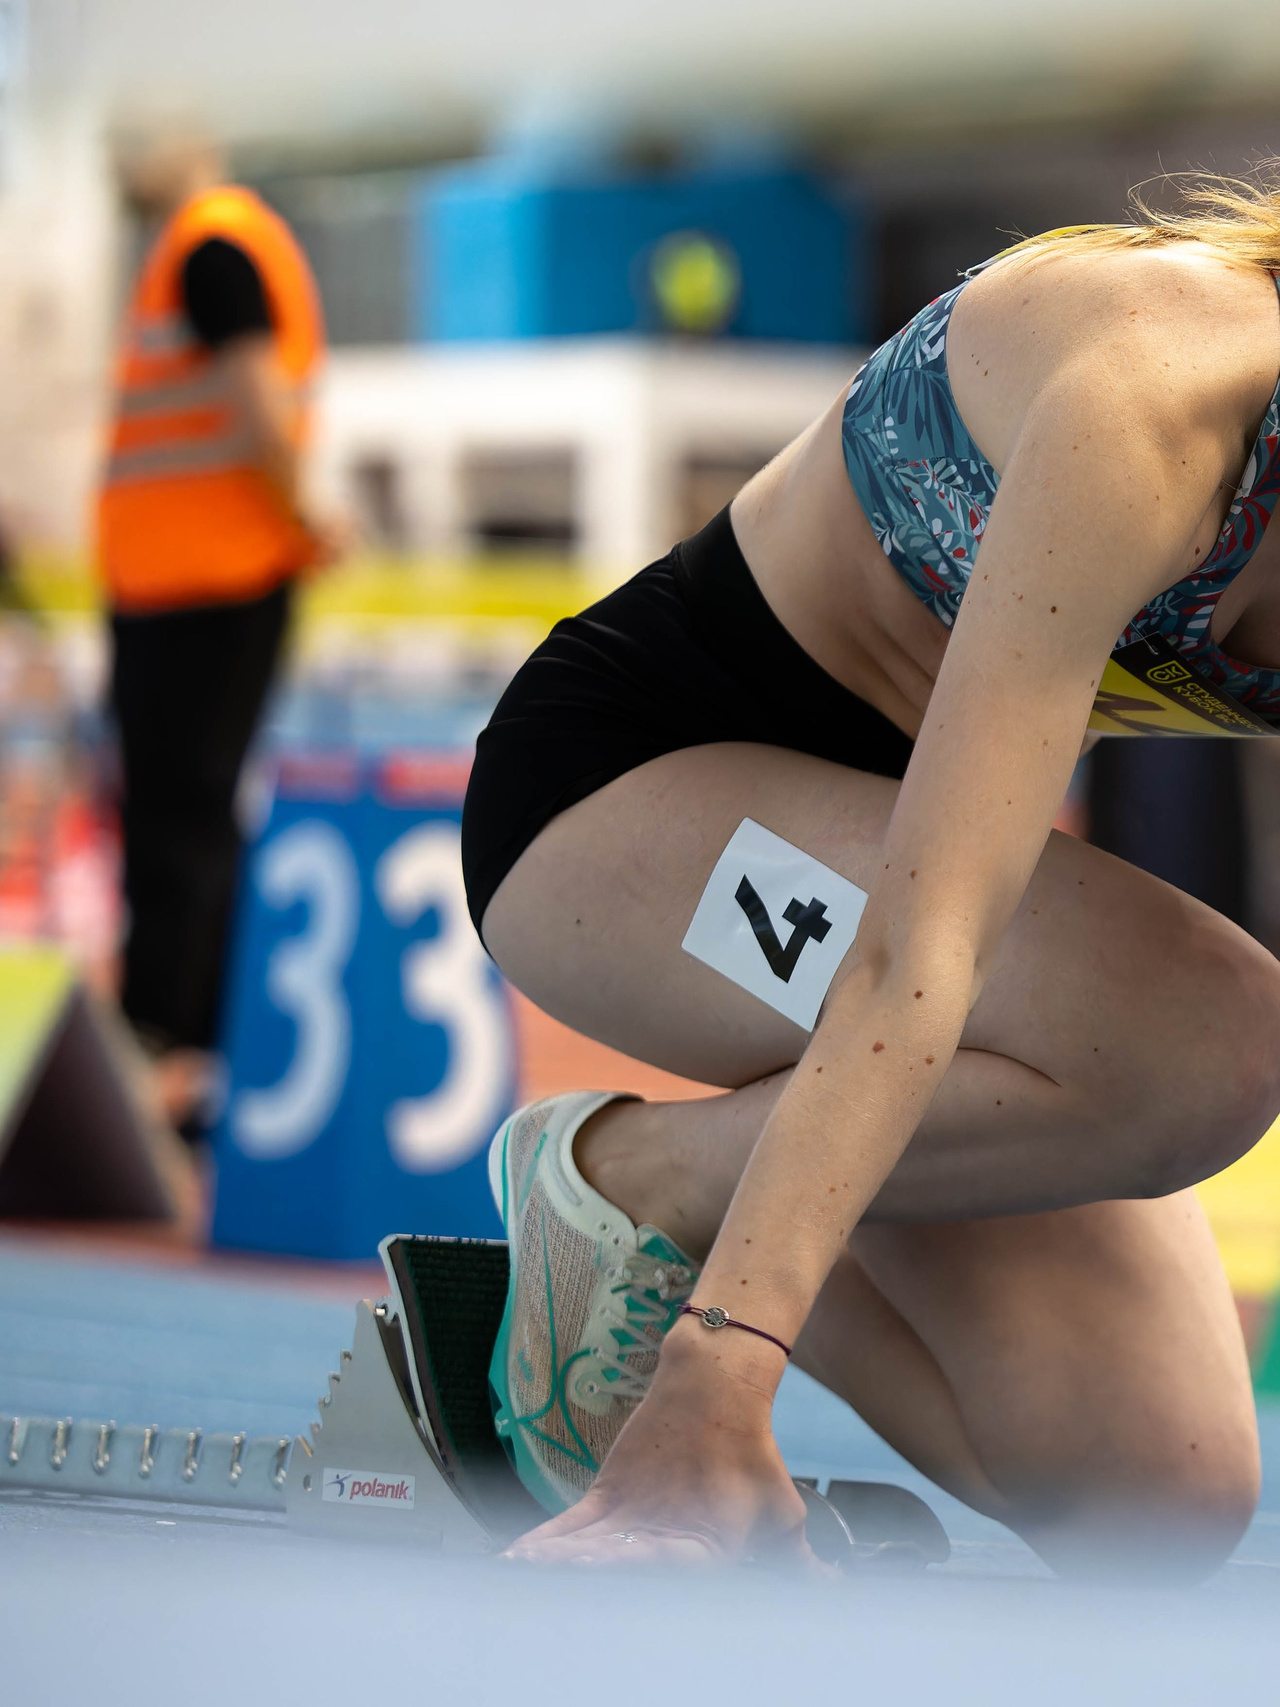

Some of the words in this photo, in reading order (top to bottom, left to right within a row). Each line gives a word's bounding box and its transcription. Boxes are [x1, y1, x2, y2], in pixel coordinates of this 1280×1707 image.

[234, 818, 360, 1159] 3
[375, 821, 513, 1173] 3
[735, 874, 833, 984] 4
[349, 1477, 410, 1501] polanik
